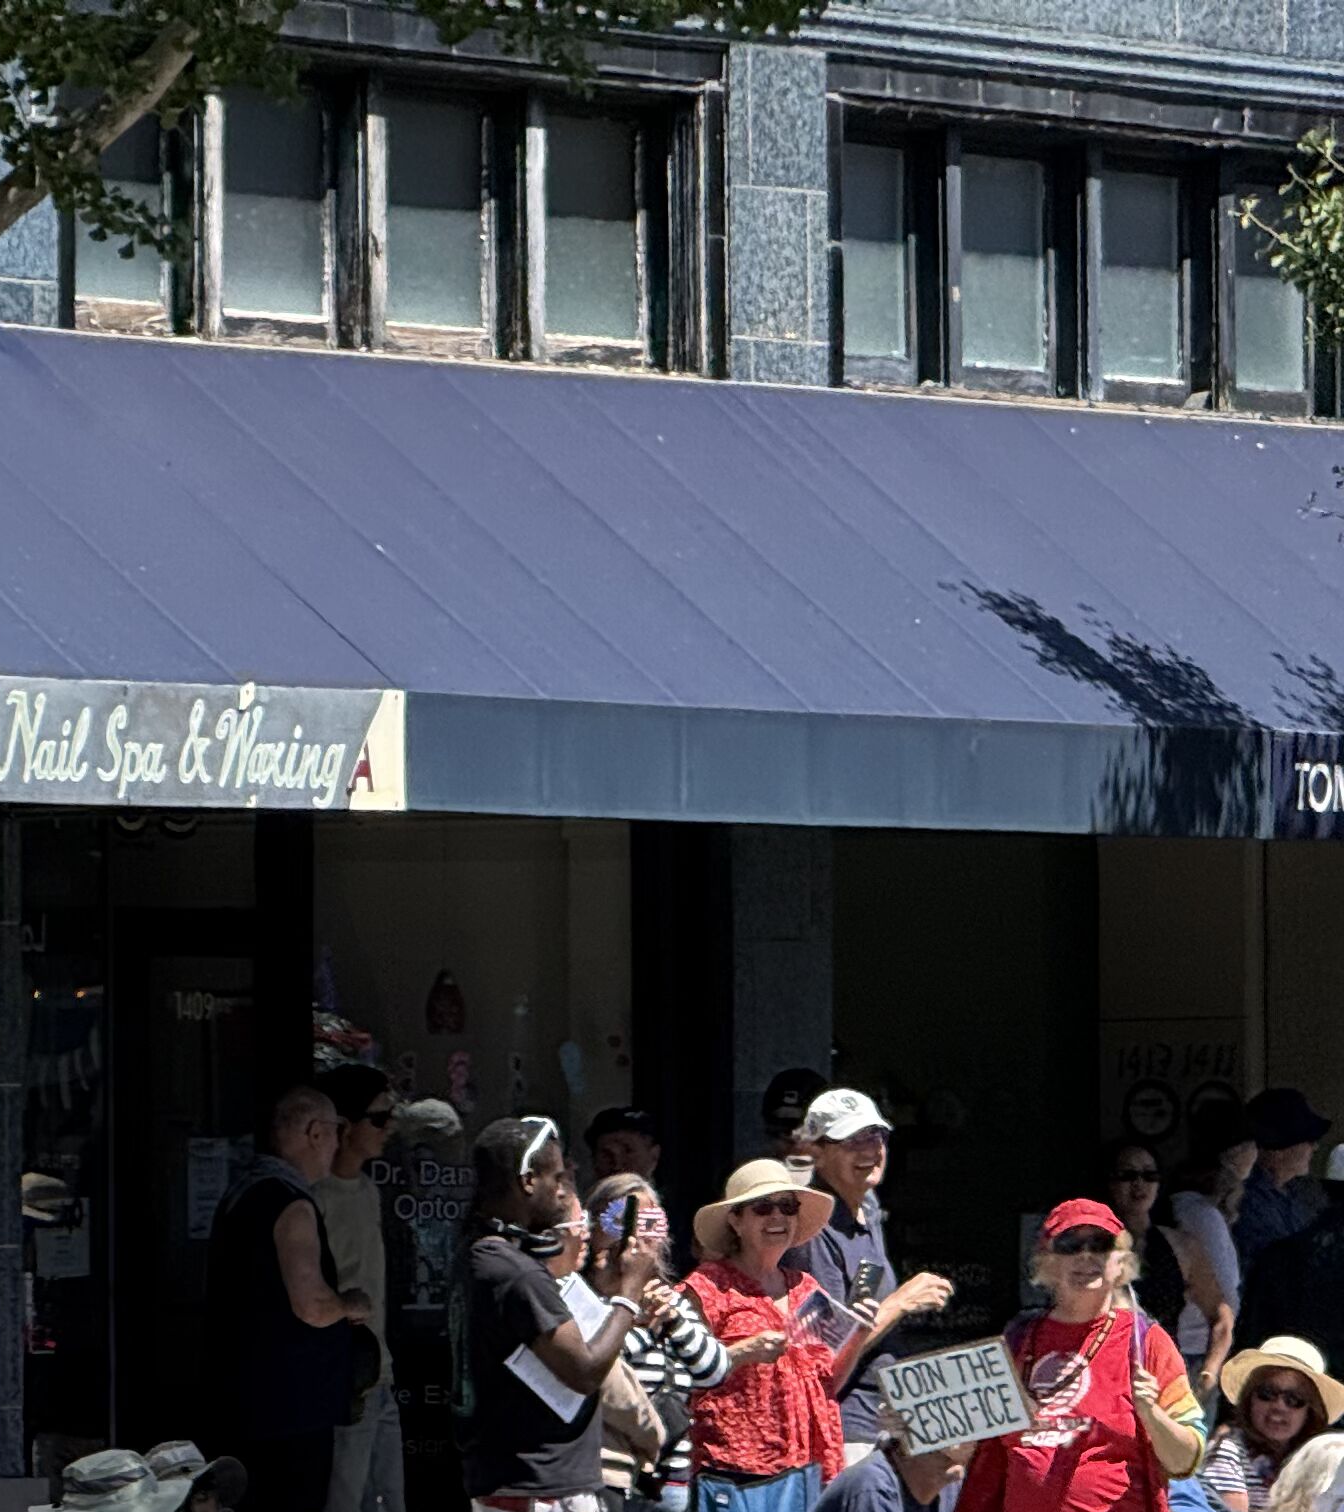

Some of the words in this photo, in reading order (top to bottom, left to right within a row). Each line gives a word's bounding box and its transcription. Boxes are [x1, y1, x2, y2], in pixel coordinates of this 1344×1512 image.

[98, 705, 166, 798] Spa
[179, 699, 211, 785] &
[216, 706, 346, 806] Waxing
[370, 1160, 406, 1184] Dr.
[886, 1361, 947, 1400] JOIN
[947, 1346, 1006, 1385] THE
[897, 1383, 1021, 1444] RESIST-ICE
